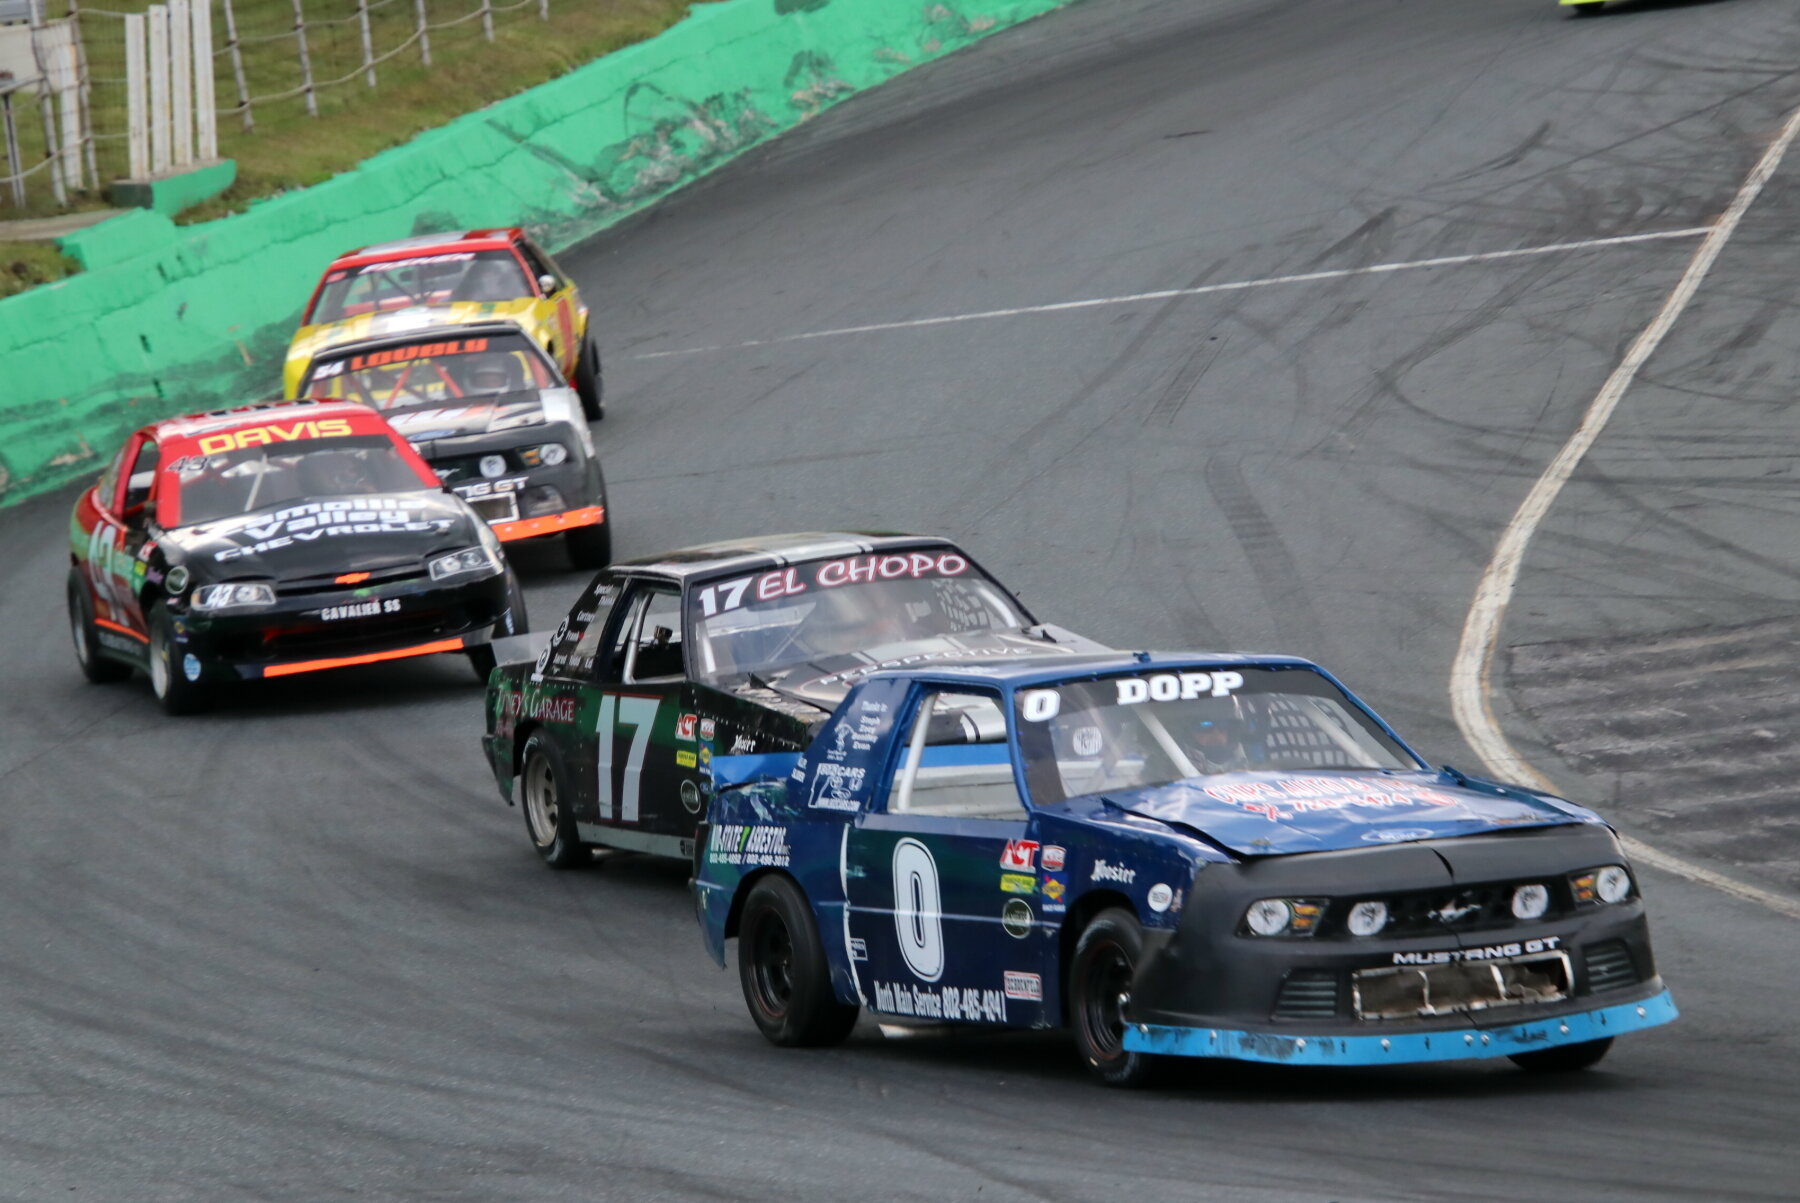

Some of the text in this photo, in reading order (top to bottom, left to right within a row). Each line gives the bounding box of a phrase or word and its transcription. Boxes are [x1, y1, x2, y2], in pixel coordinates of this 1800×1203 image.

[199, 419, 353, 455] DAVIS
[494, 476, 529, 493] GT
[214, 518, 455, 562] CHEVROLET
[244, 510, 409, 540] Valley
[699, 554, 967, 617] 17 EL CHOPO
[321, 599, 401, 620] CAVALIER SS
[1116, 671, 1243, 705] DOPP
[530, 689, 575, 721] GARAGE
[1023, 689, 1060, 722] 0
[595, 693, 661, 823] 17
[1000, 838, 1039, 867] ACT
[893, 837, 945, 982] 0
[1393, 936, 1560, 964] MUSTANG GT
[874, 980, 895, 1012] North
[893, 982, 915, 1015] Main
[912, 984, 942, 1018] Service
